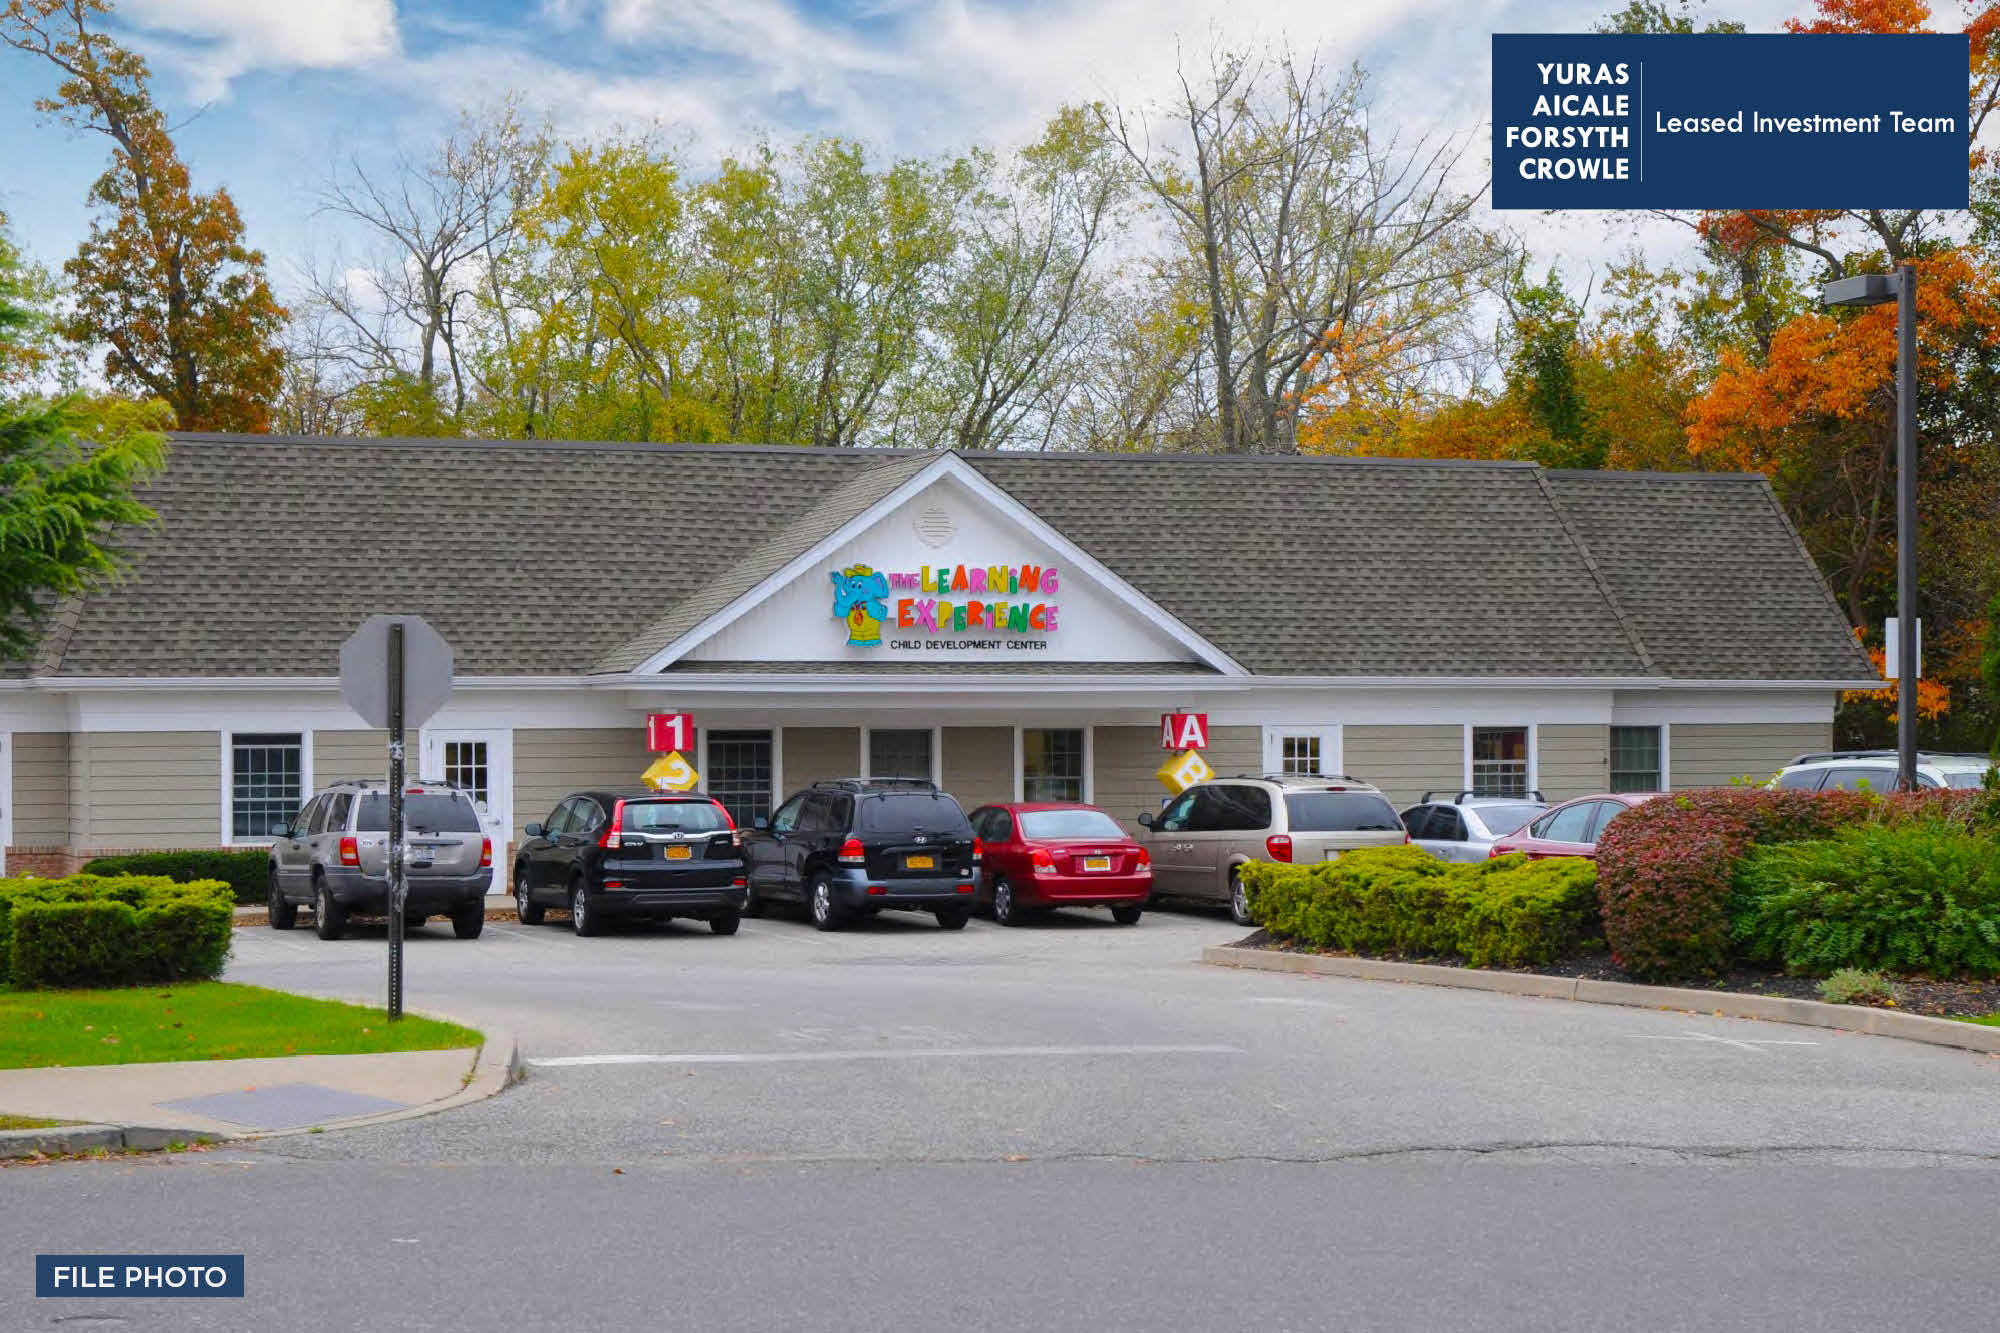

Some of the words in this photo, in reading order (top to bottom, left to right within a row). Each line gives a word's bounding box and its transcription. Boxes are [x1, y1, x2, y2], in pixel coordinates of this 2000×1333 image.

[888, 573, 920, 590] THE
[890, 640, 922, 650] CHILD
[926, 640, 1002, 650] DEVELOPMENT
[1006, 640, 1047, 650] CENTER
[665, 715, 683, 750] 1
[1162, 715, 1175, 748] A
[1179, 714, 1206, 748] A
[1175, 753, 1207, 789] B
